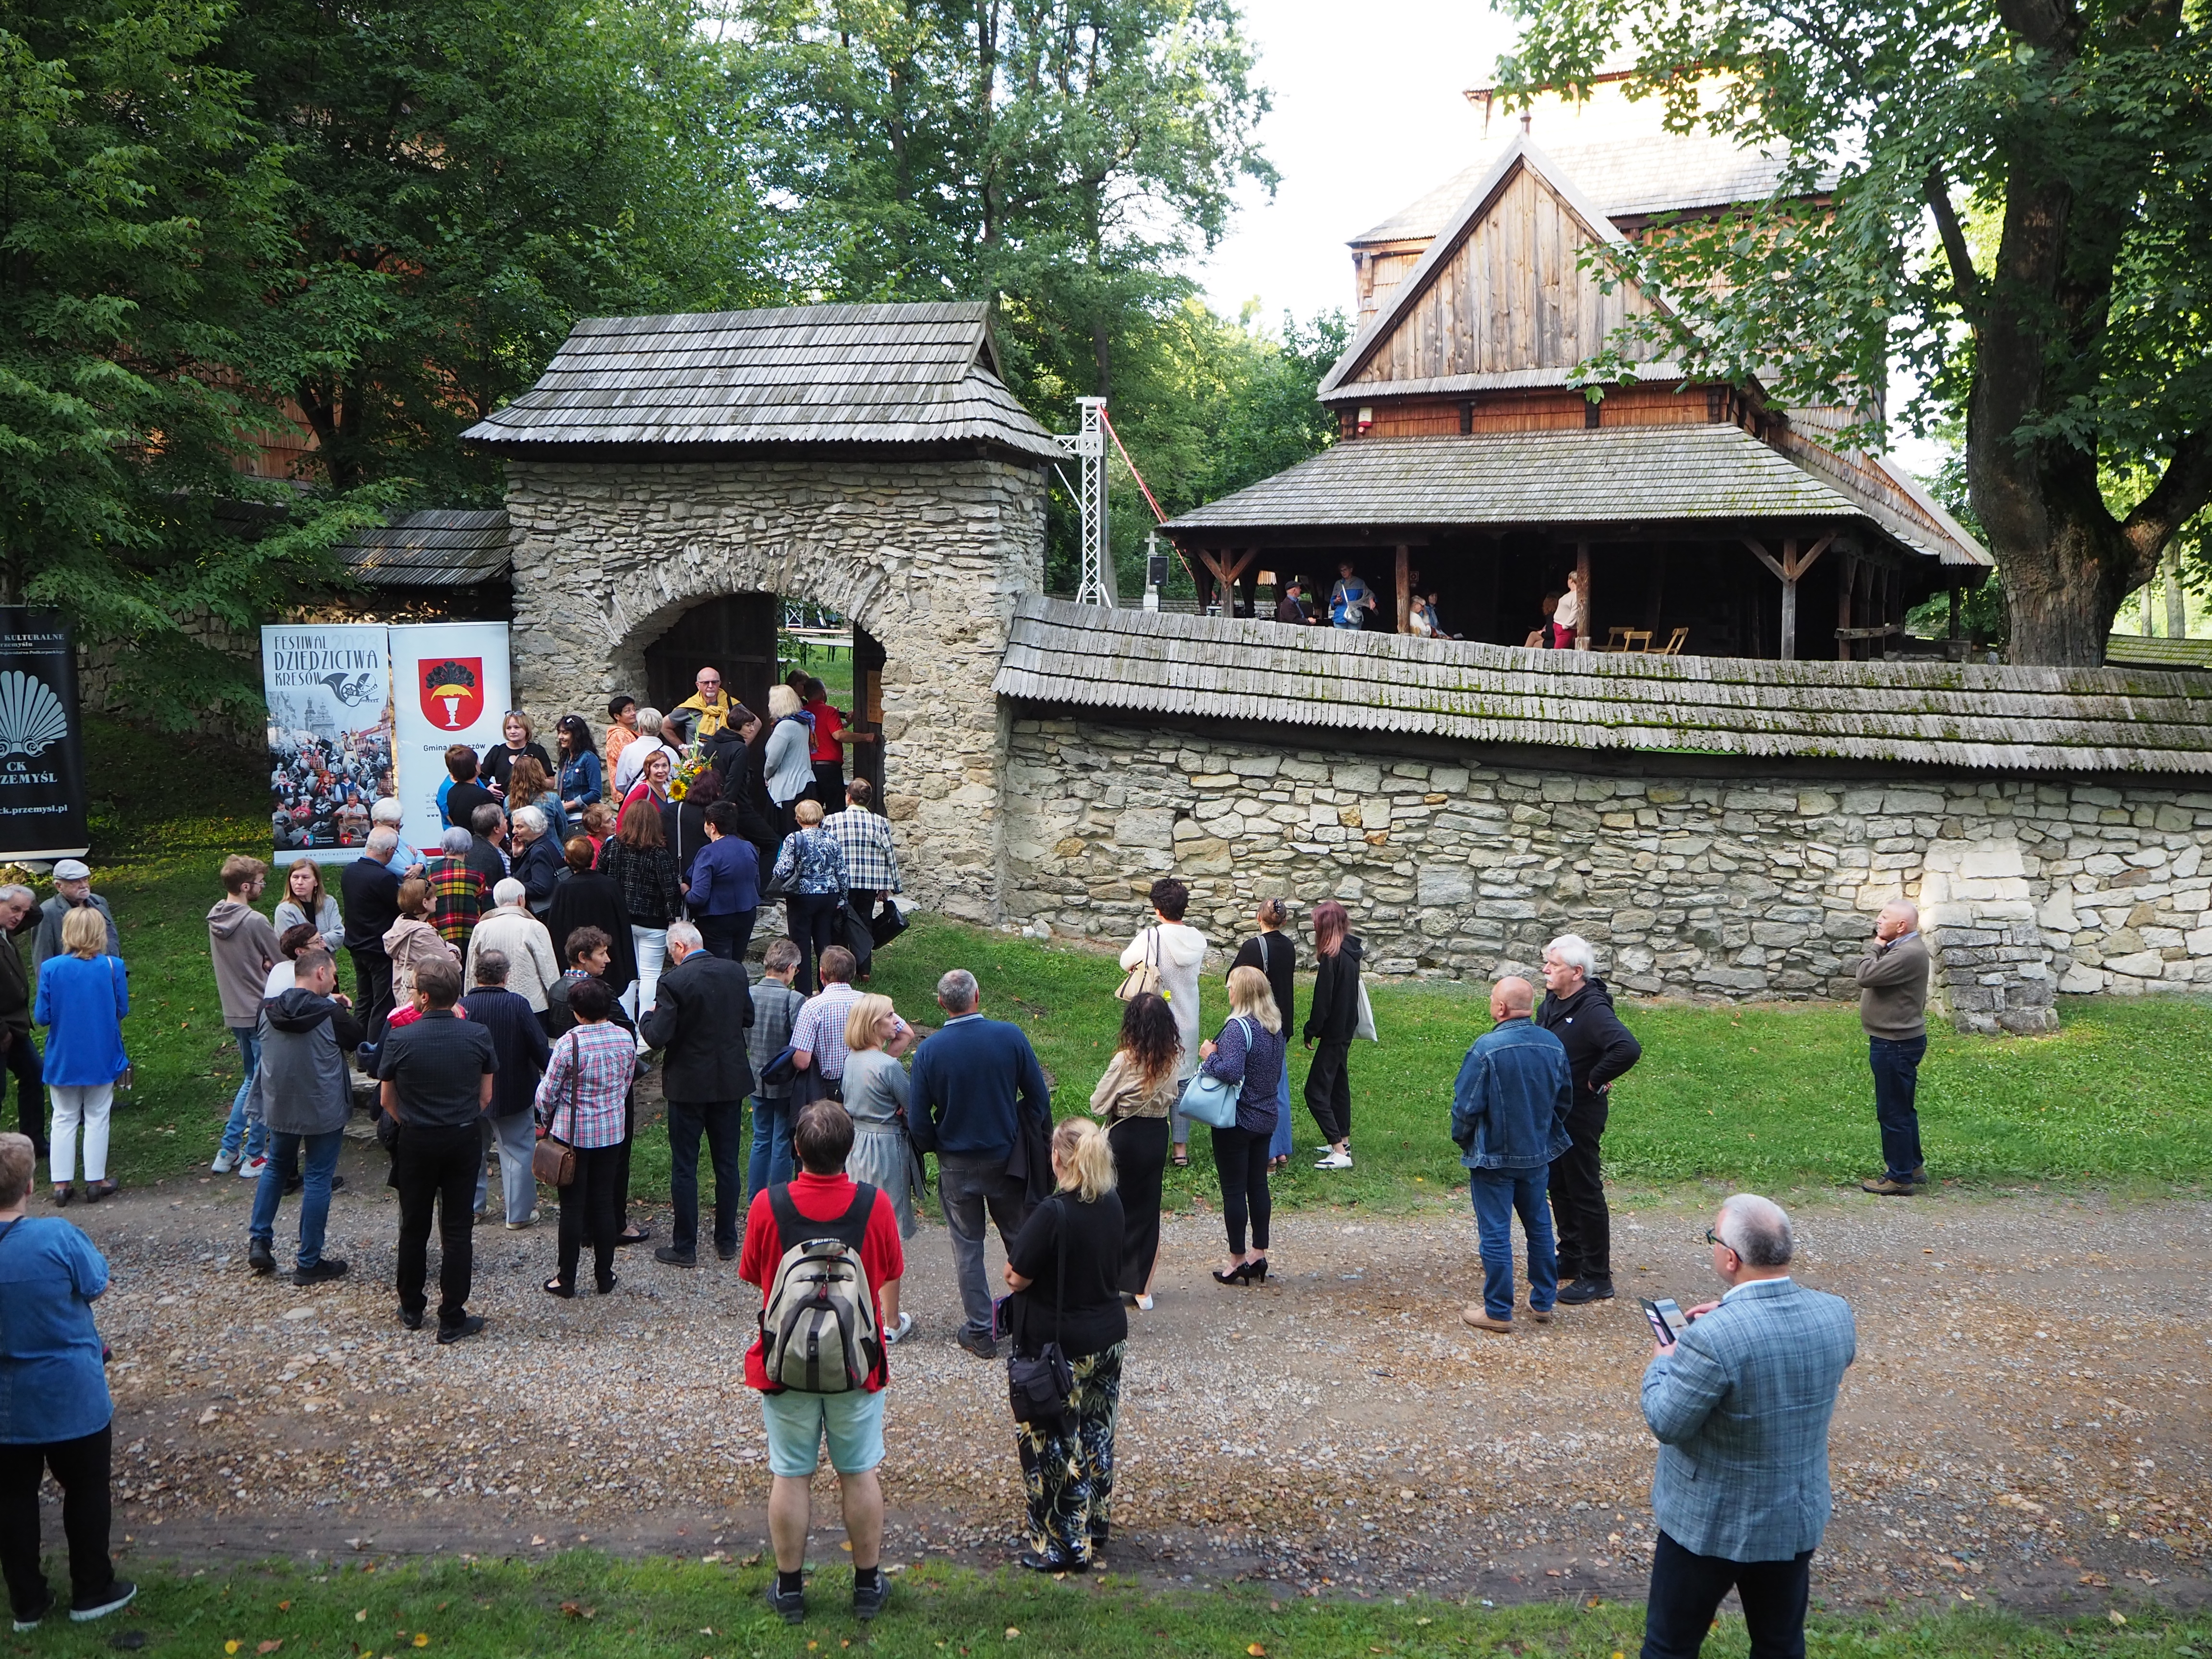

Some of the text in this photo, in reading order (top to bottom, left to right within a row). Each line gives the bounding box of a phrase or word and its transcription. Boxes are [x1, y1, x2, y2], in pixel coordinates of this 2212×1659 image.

[275, 634, 379, 652] FESTIWAL 2023
[275, 650, 378, 671] DZIEDZICTWA
[275, 670, 321, 686] KRESÓW
[6, 761, 27, 771] CK
